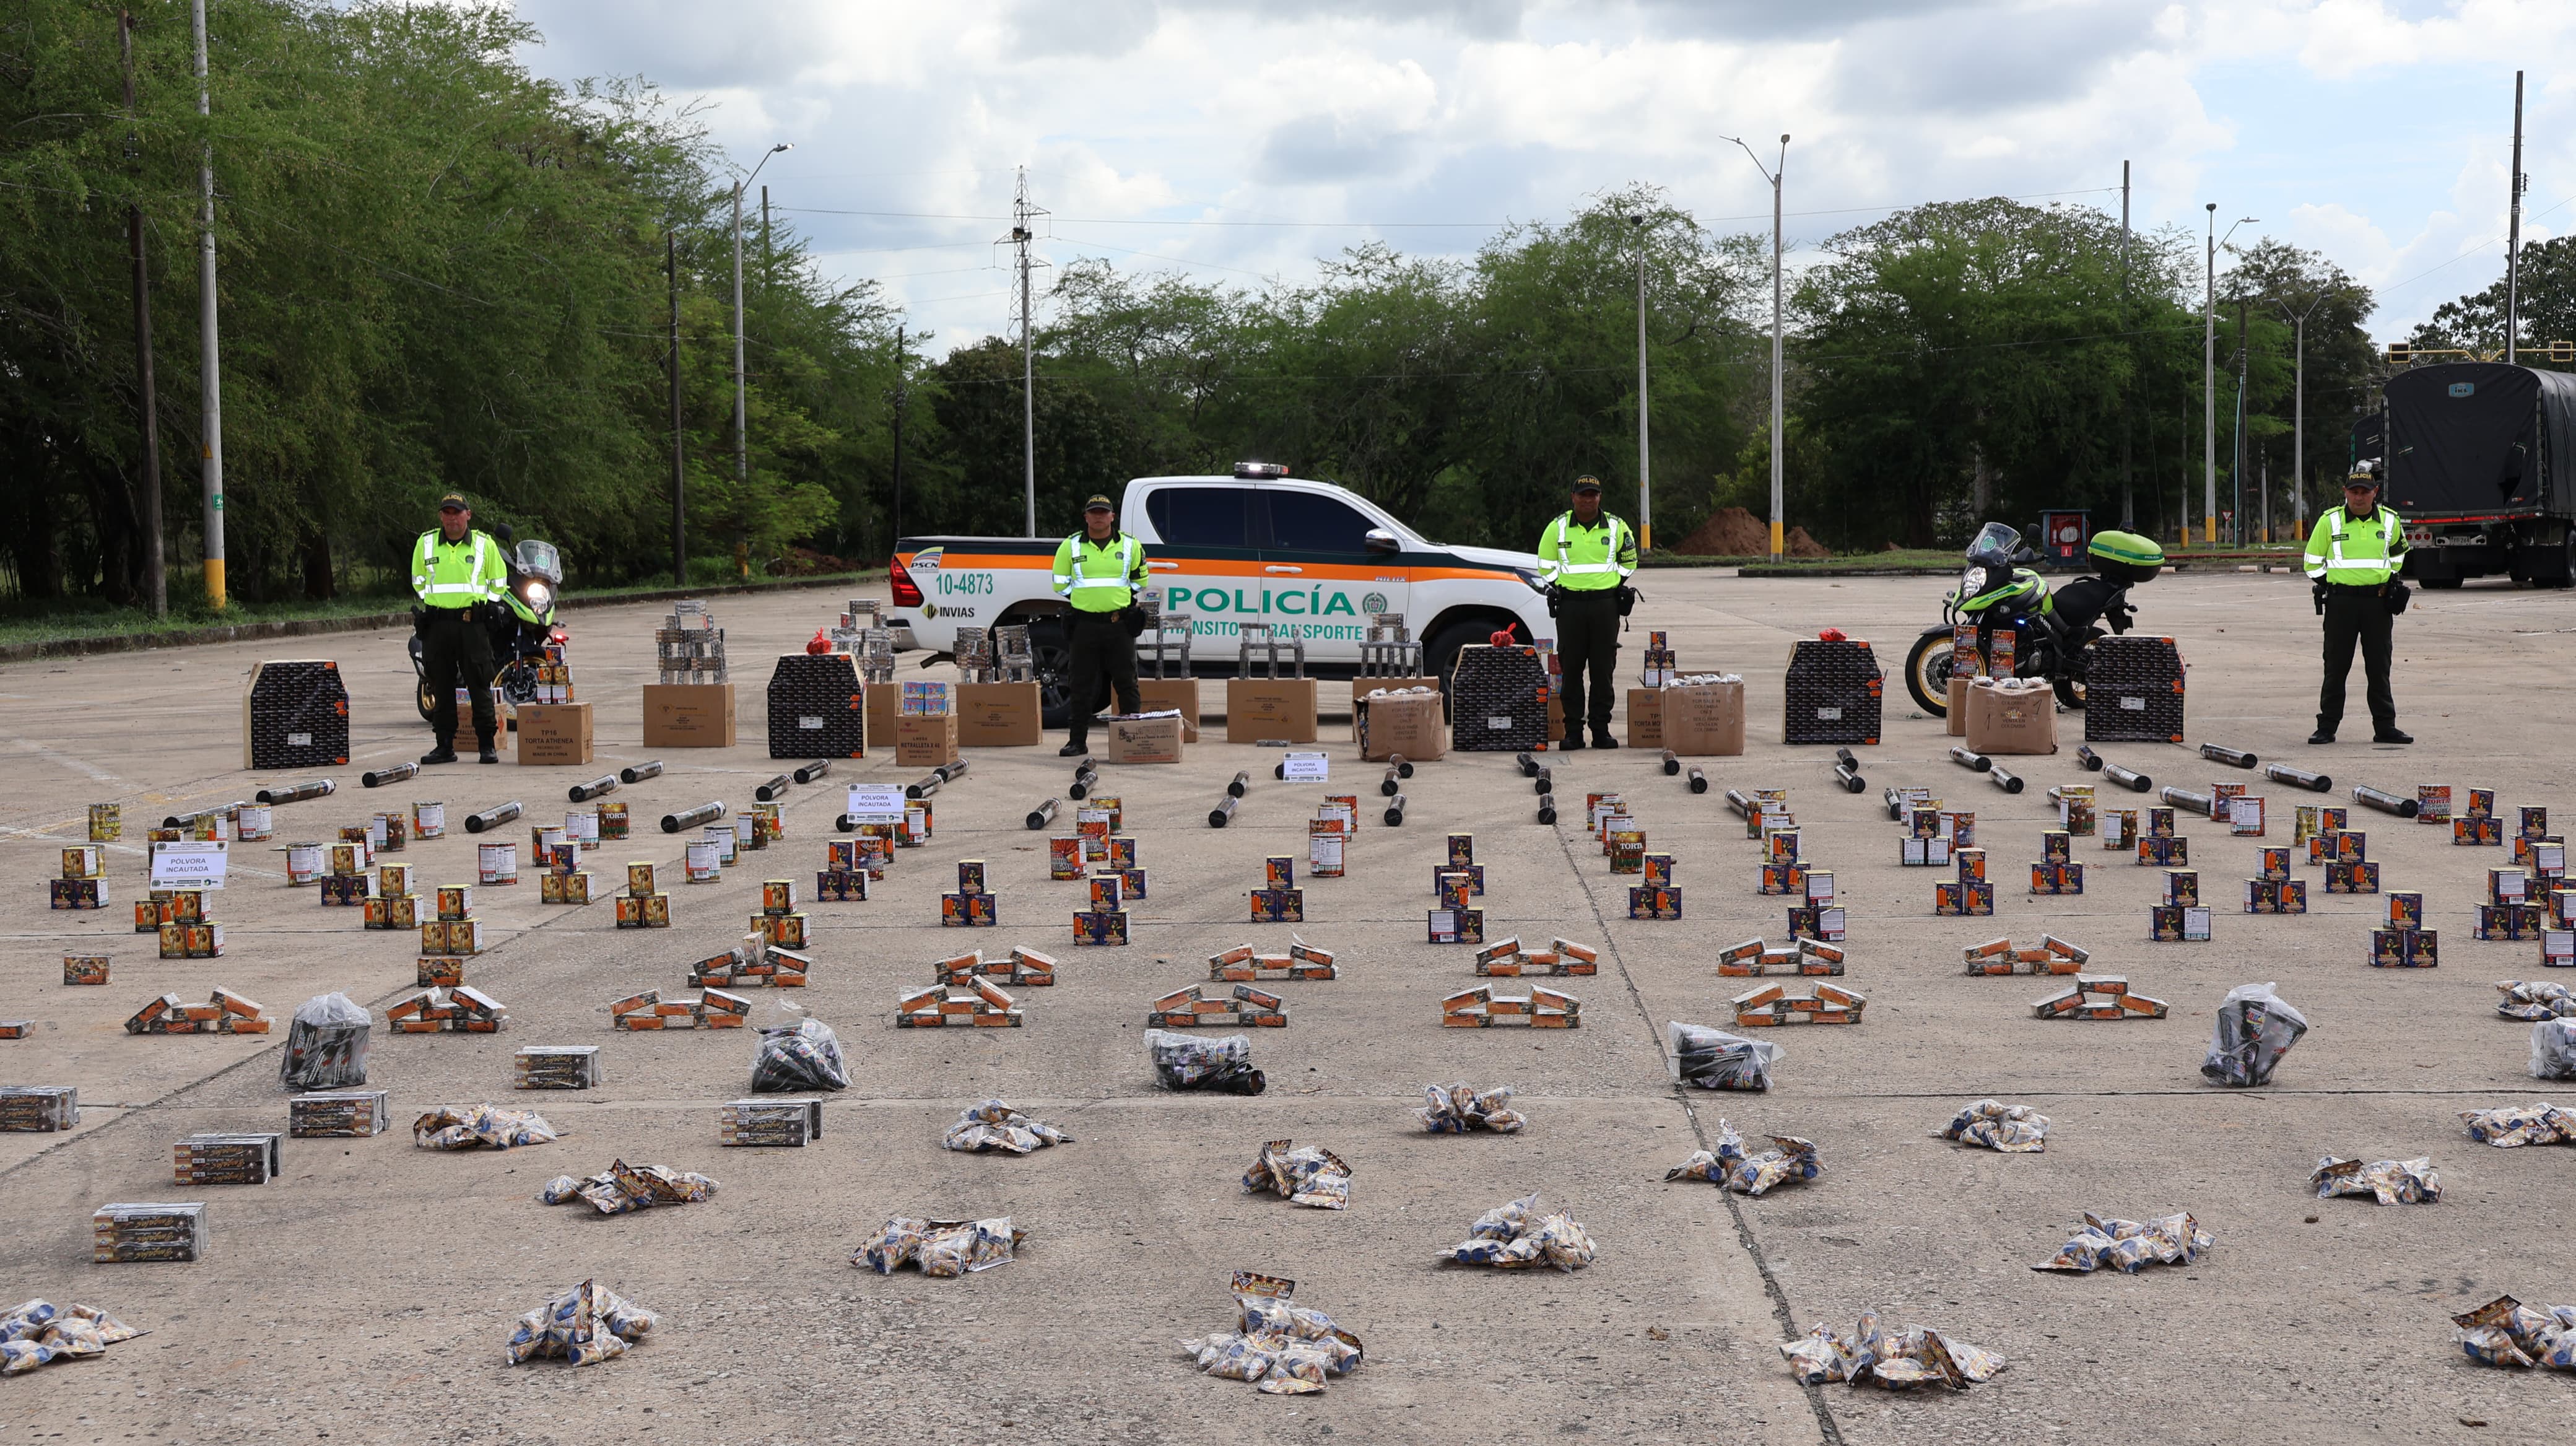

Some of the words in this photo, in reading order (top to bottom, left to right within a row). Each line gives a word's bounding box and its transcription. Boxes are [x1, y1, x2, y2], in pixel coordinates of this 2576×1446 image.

[1578, 477, 1600, 486] POLICIA
[936, 573, 993, 595] 10-4873
[1168, 584, 1356, 616] POLICÍA
[939, 606, 975, 618] INVIAS
[1620, 842, 1643, 850] TORTA
